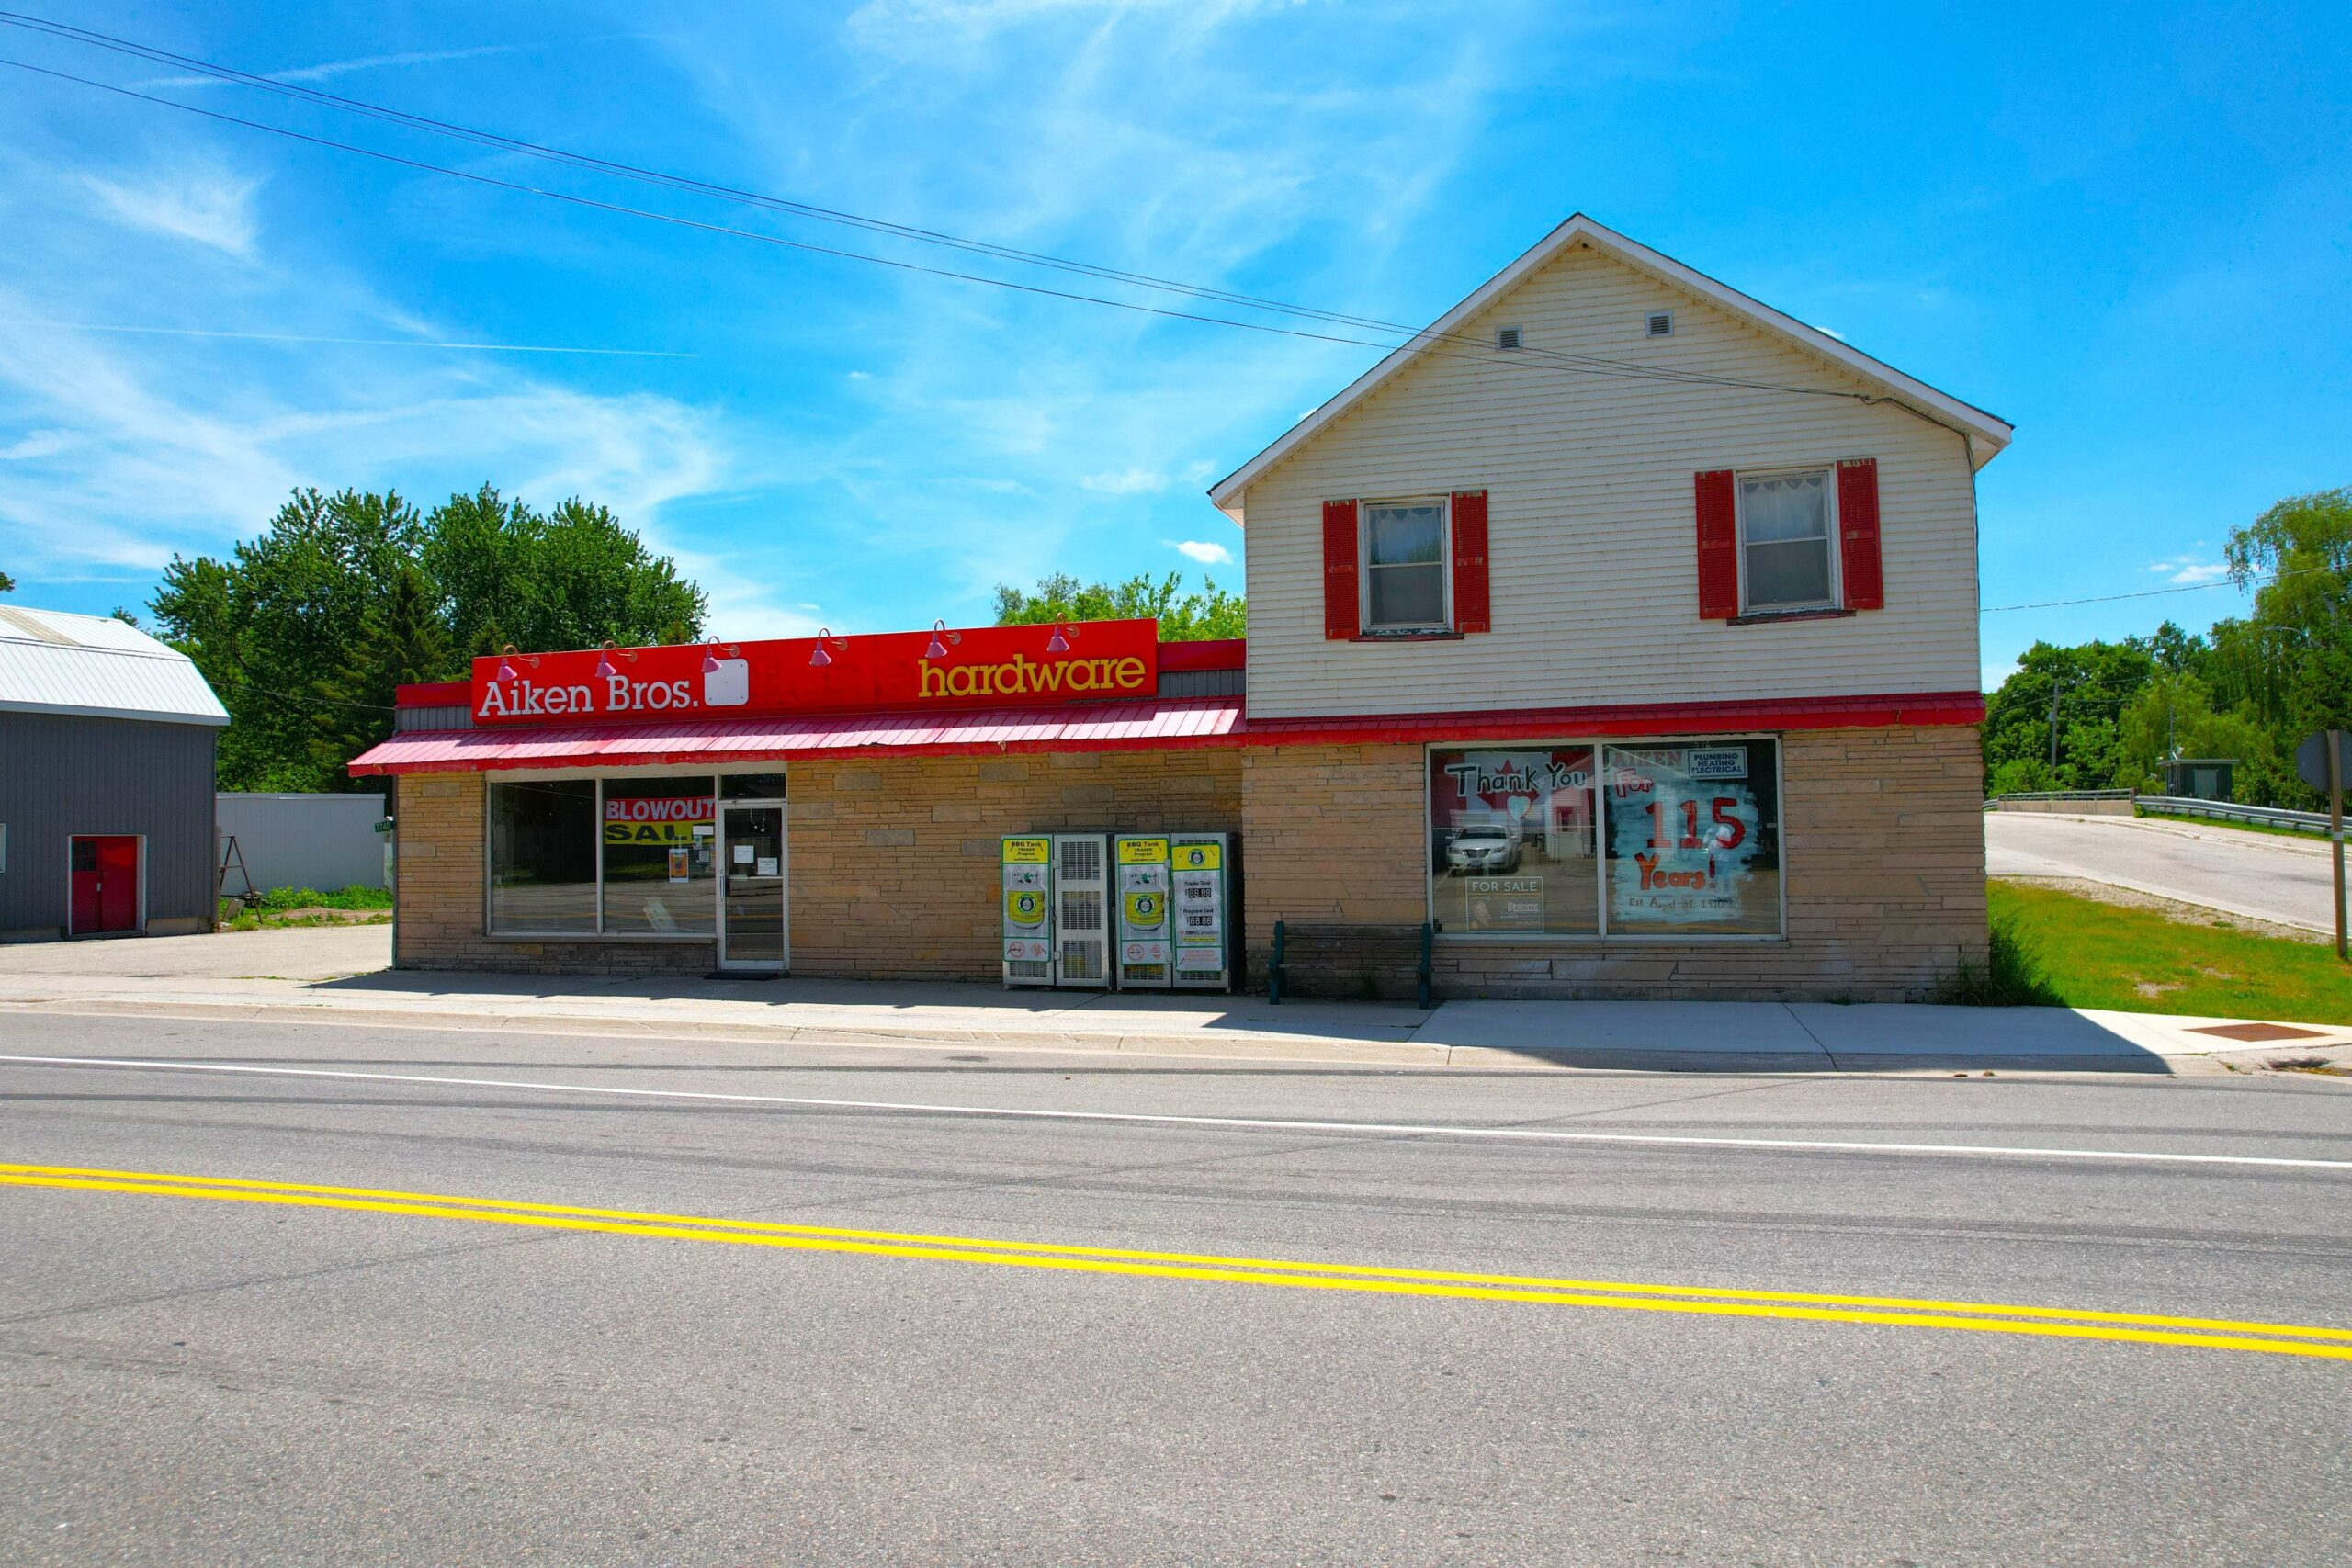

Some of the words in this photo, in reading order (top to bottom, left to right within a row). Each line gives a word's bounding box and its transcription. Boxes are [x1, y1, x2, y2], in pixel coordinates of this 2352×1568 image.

[918, 653, 1146, 698] hardware
[477, 679, 595, 716] Aiken
[605, 675, 699, 712] Bros.
[1694, 752, 1738, 761] PLUMBING
[1445, 763, 1540, 796] Thank
[1545, 762, 1587, 789] You
[1615, 768, 1654, 797] For
[605, 798, 715, 819] BLOWOUT
[1645, 797, 1746, 849] 115
[1472, 881, 1499, 892] FOR
[1504, 881, 1538, 892] SALE
[1634, 851, 1716, 890] Years!
